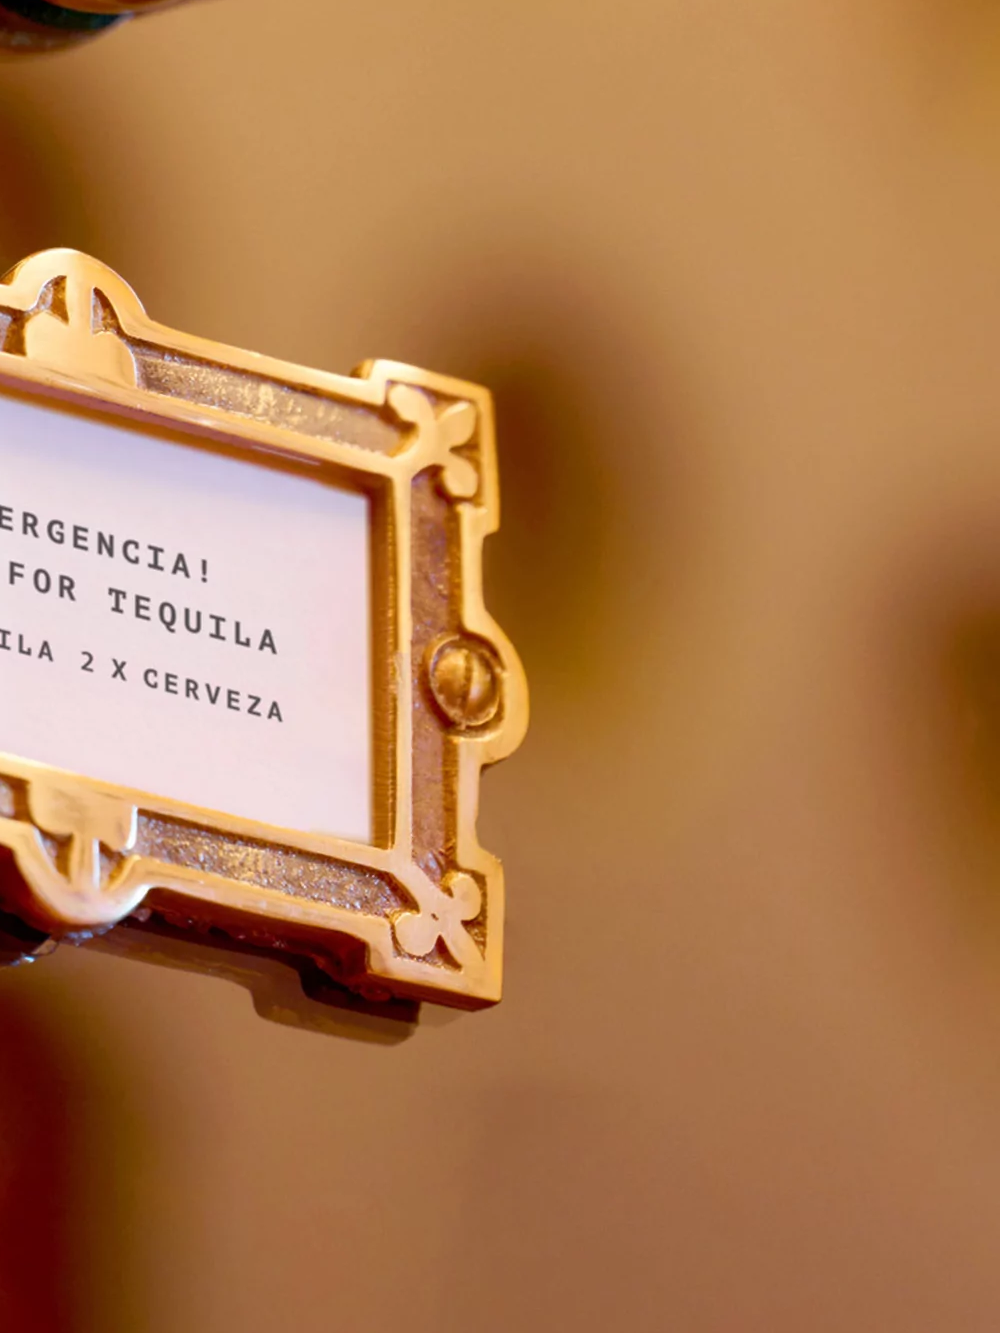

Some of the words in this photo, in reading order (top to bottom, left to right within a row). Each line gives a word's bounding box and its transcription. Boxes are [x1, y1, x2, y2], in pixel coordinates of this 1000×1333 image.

[9, 561, 76, 602] FOR
[108, 587, 277, 655] TEQUILA
[80, 651, 95, 673] 2
[111, 658, 127, 681] X
[143, 668, 283, 723] CERVEZA
